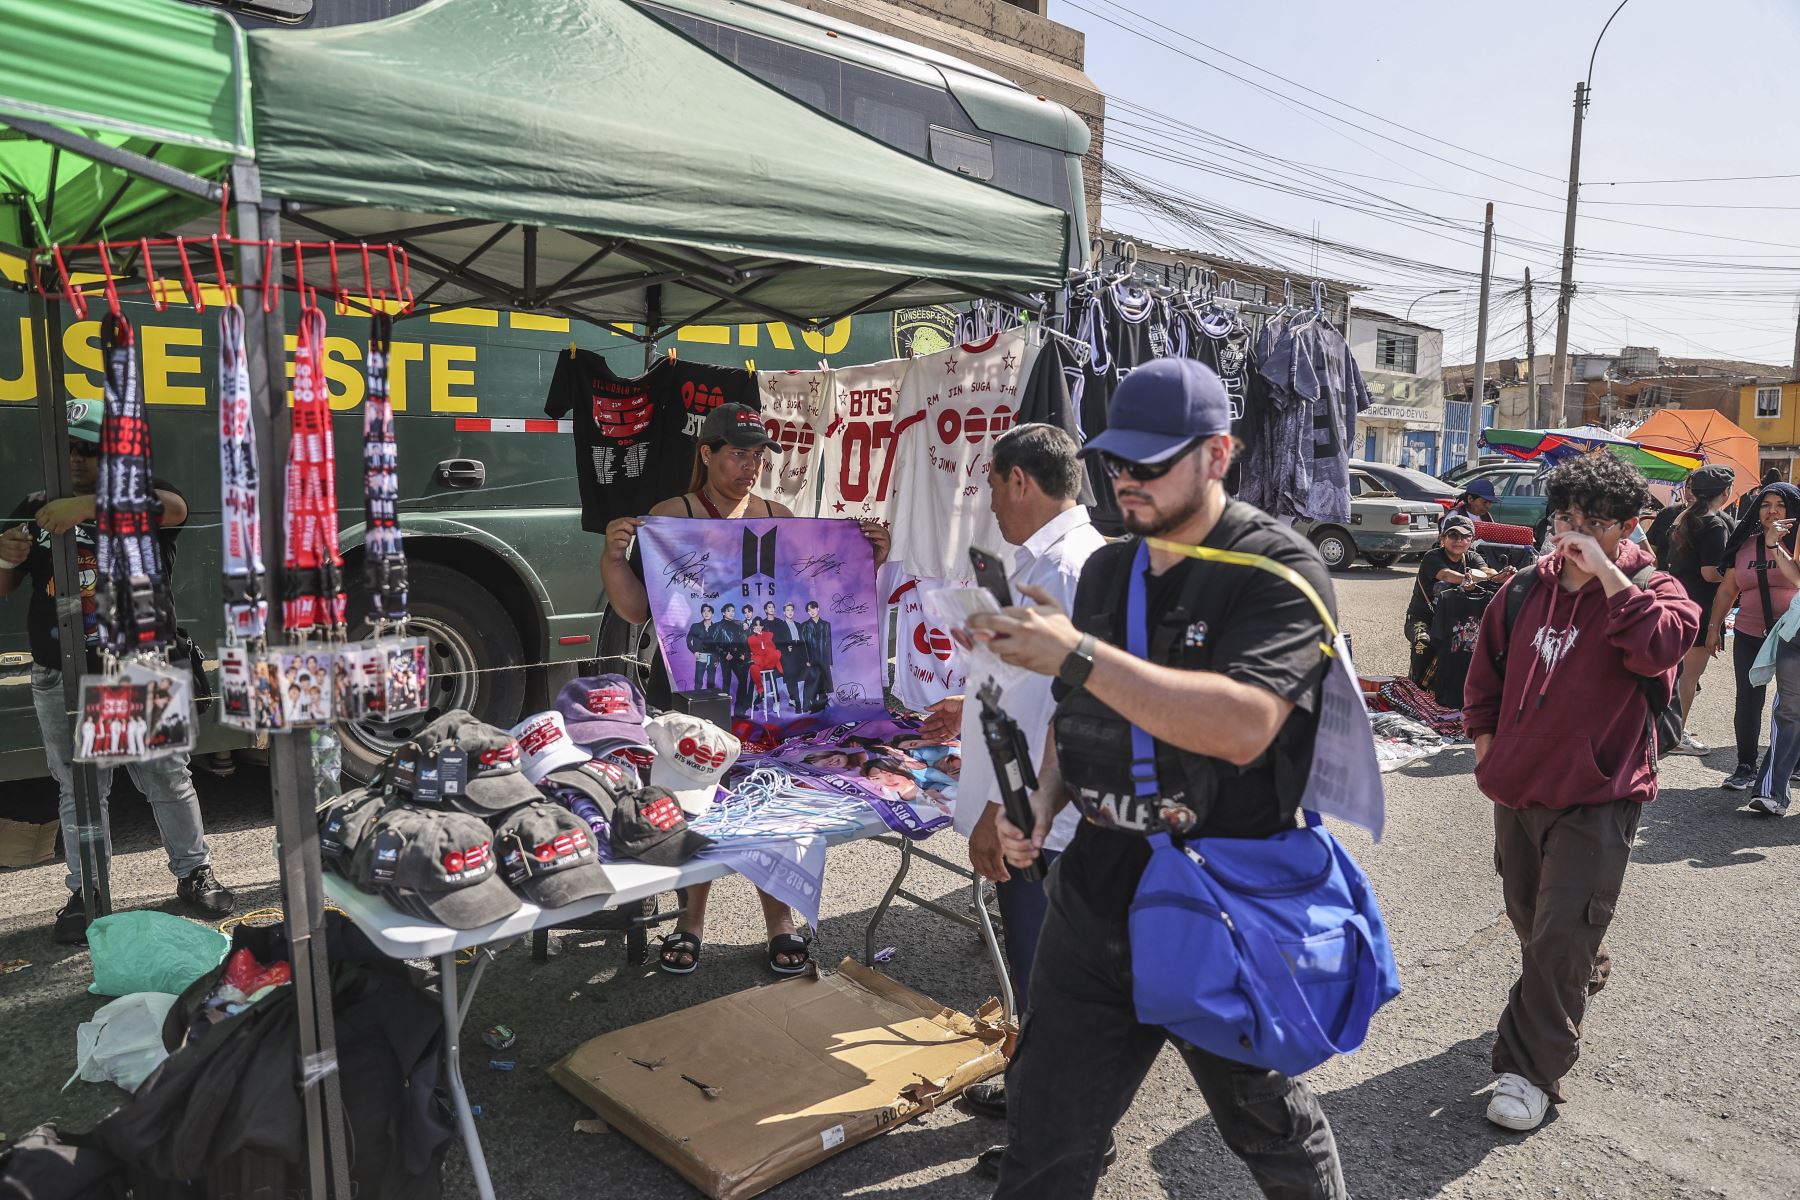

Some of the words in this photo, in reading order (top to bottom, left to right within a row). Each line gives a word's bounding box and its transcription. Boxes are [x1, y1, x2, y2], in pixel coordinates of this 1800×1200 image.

[849, 387, 892, 417] BTS
[926, 393, 940, 408] RM
[947, 385, 963, 399] JIN
[971, 382, 991, 393] SUGA
[681, 412, 706, 438] BT
[1406, 410, 1429, 420] DEYVIS
[840, 421, 900, 502] 07
[938, 457, 957, 474] JIMIN
[123, 536, 145, 577] ARIRANG
[741, 582, 776, 597] BTS
[913, 665, 935, 684] JIMIN
[607, 754, 619, 764] BTS
[674, 752, 687, 763] BTS
[686, 758, 706, 772] WORLD
[892, 804, 911, 824] BTS
